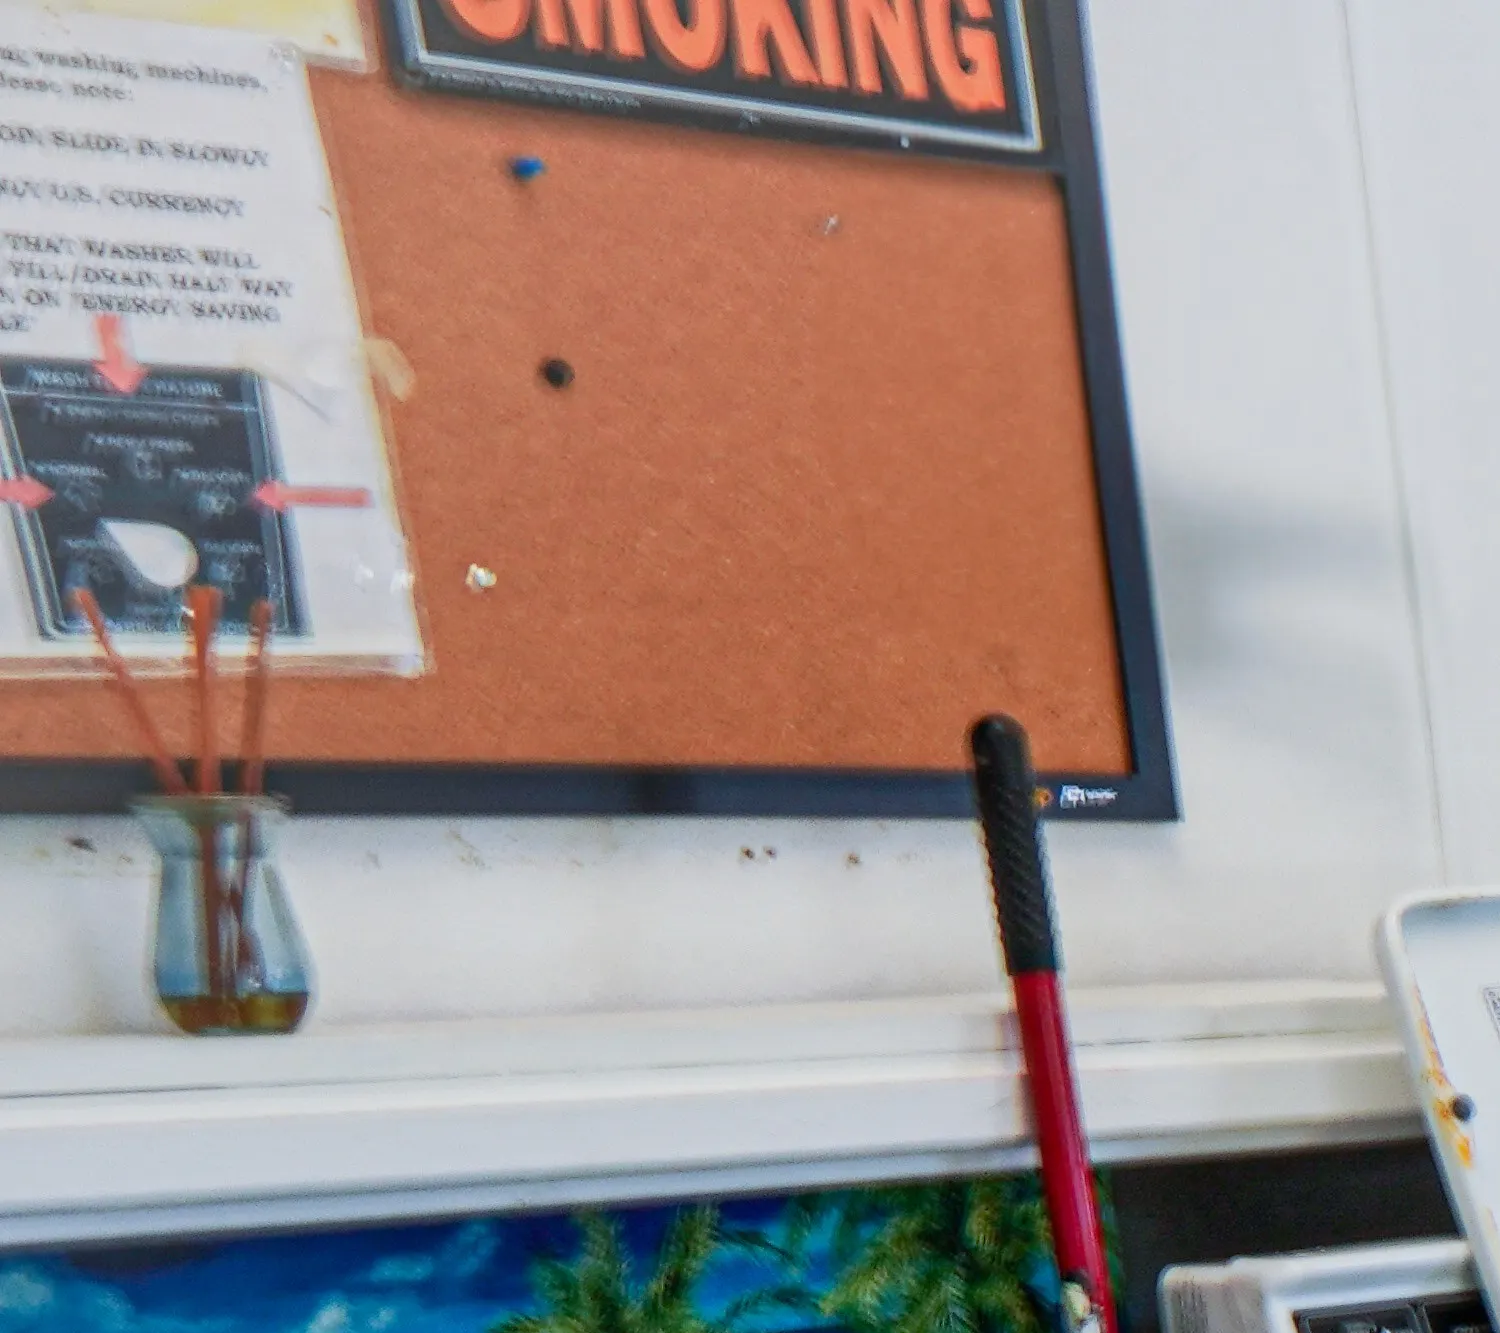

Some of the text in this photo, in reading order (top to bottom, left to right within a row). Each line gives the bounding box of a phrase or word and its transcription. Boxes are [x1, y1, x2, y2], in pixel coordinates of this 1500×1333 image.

[35, 49, 139, 80] washing
[435, 0, 1008, 114] OKING
[72, 80, 134, 101] note:
[50, 130, 130, 154] SLIDE
[137, 139, 163, 158] IN
[168, 143, 270, 168] SLOWLY
[108, 189, 245, 218] CURRENCY
[4, 231, 261, 271] THAT WASHER WILL
[168, 272, 231, 294] HALF
[239, 277, 295, 299] WAY
[24, 288, 61, 307] ON
[189, 301, 282, 324] SAVING
